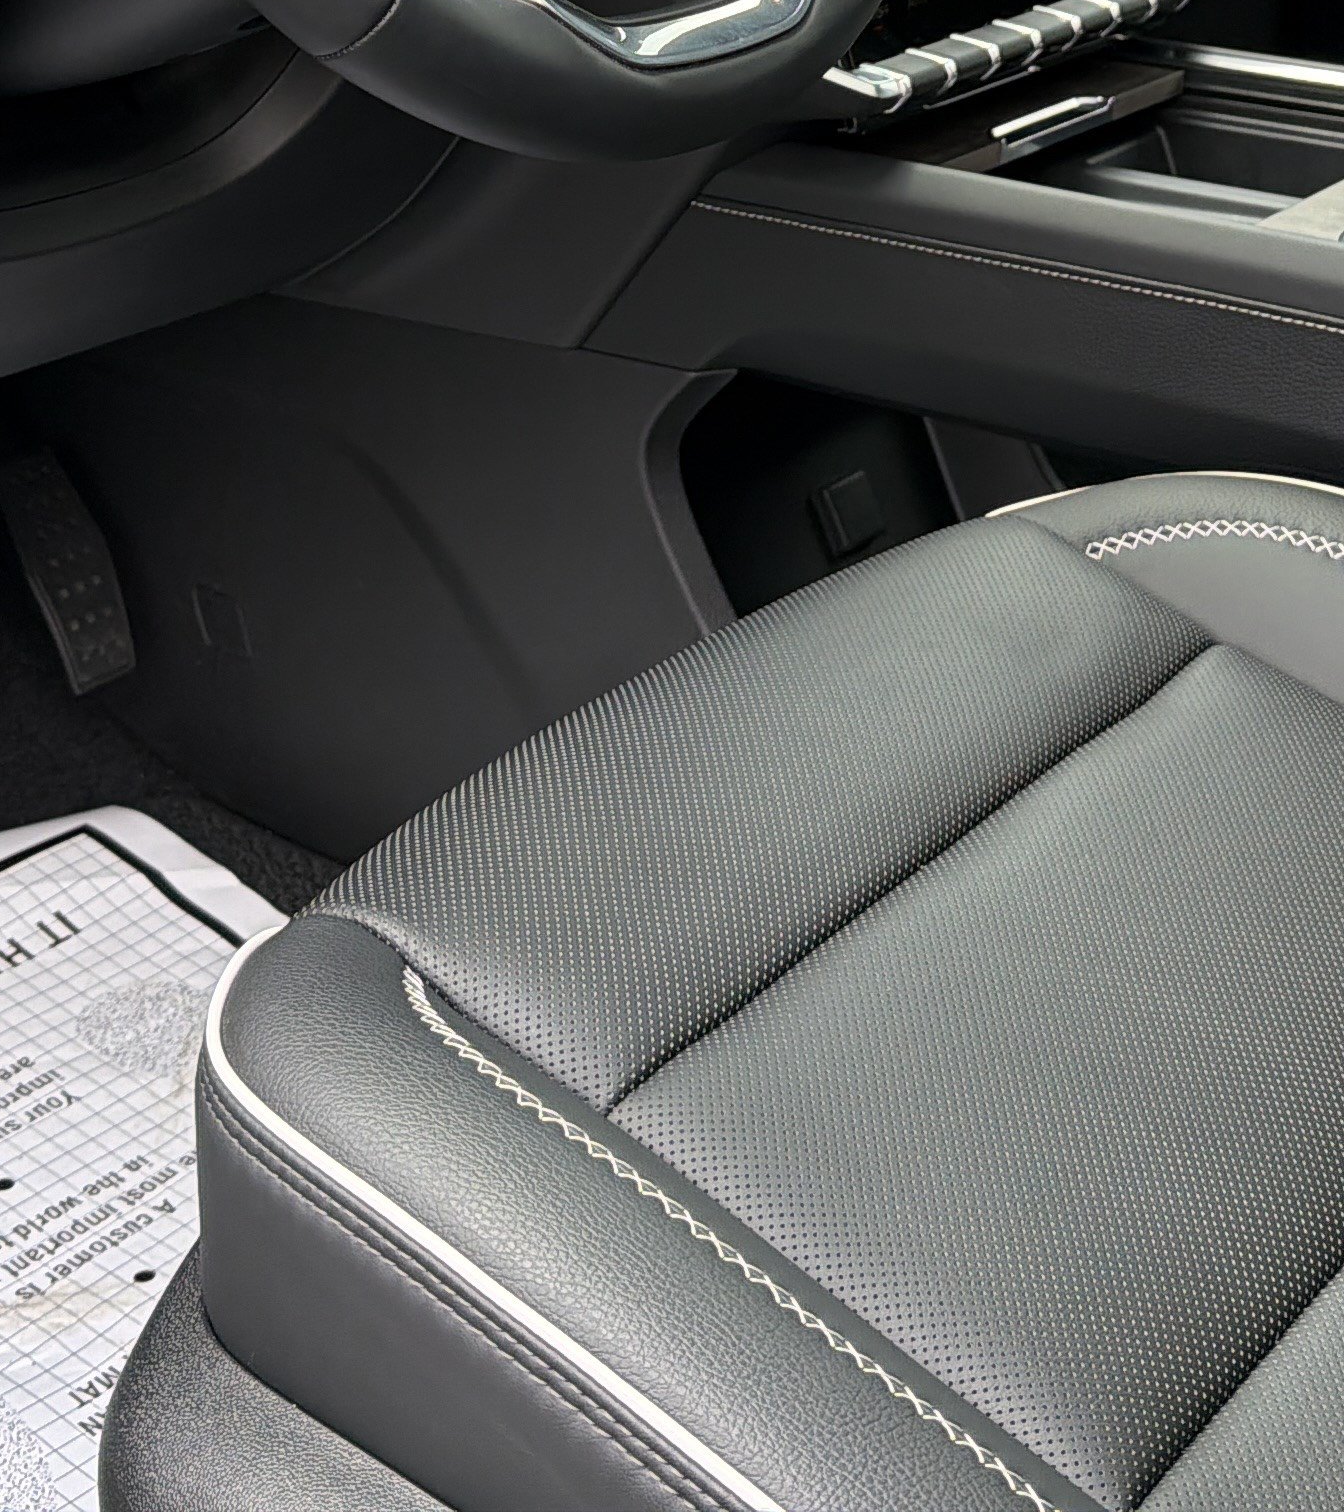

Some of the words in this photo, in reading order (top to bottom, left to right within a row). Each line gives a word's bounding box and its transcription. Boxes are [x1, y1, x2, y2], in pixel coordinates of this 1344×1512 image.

[37, 910, 81, 949] IT
[24, 1090, 82, 1123] Your
[123, 1154, 155, 1172] in
[82, 1170, 125, 1196] the
[117, 1166, 178, 1207] most
[13, 1195, 83, 1240] world
[152, 1197, 177, 1215] A
[0, 1203, 122, 1278] important
[44, 1213, 154, 1284] customer
[14, 1284, 47, 1301] is
